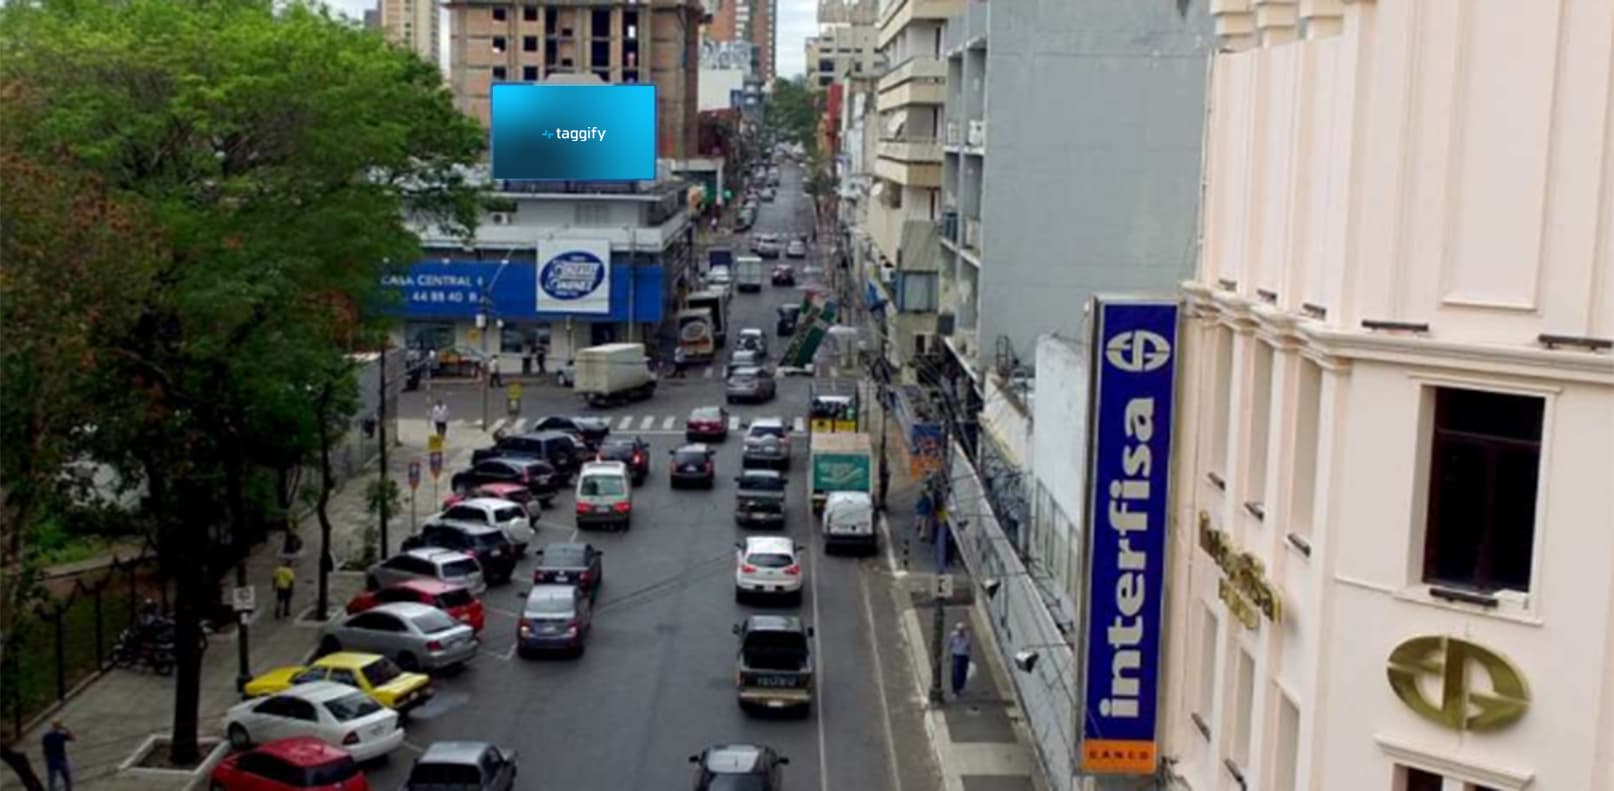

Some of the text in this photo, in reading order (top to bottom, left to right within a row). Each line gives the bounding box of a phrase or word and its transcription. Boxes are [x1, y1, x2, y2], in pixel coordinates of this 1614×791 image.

[556, 126, 606, 142] taggify
[417, 274, 472, 287] CENTRAL
[1099, 397, 1155, 718] interfisa
